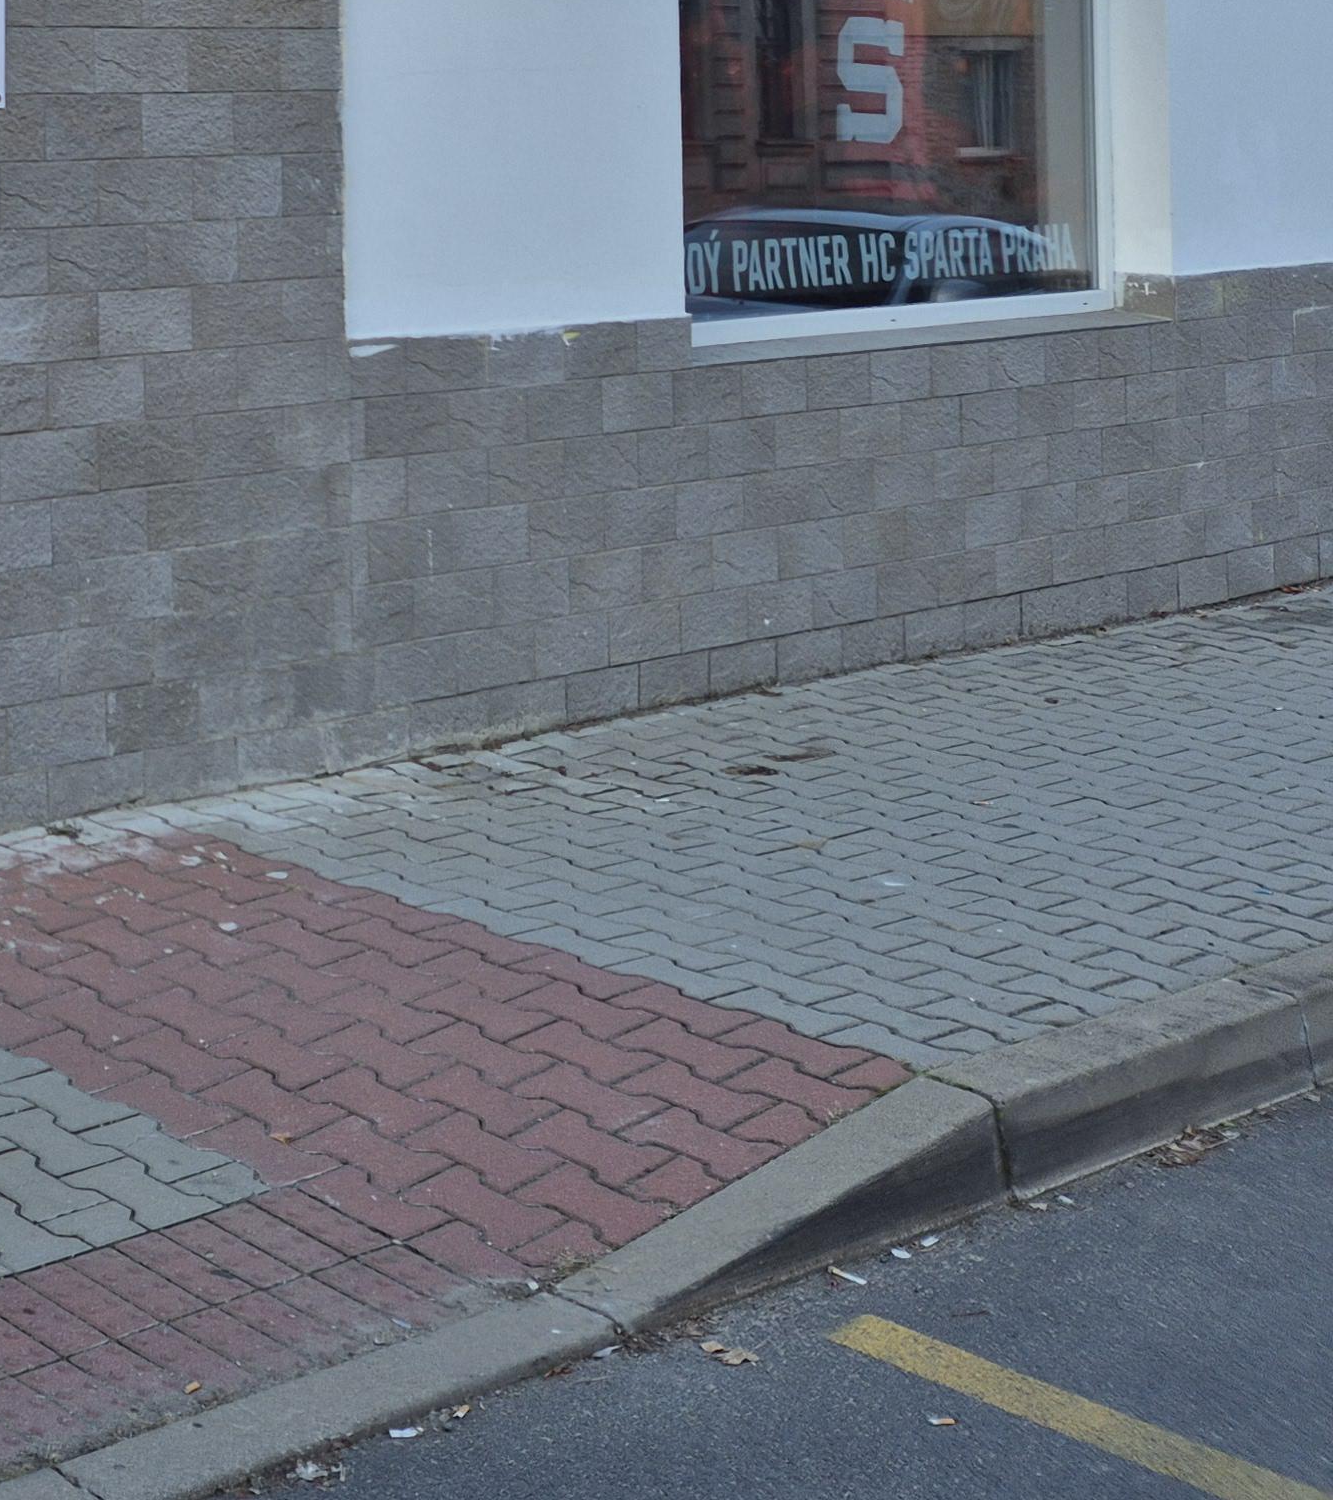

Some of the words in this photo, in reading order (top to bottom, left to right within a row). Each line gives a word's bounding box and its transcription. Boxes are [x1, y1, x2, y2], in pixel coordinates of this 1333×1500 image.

[836, 16, 904, 144] S
[732, 232, 850, 292] PARTNER
[861, 232, 896, 283] HC
[904, 226, 993, 280] SPARTA
[1000, 223, 1077, 272] PRAHA
